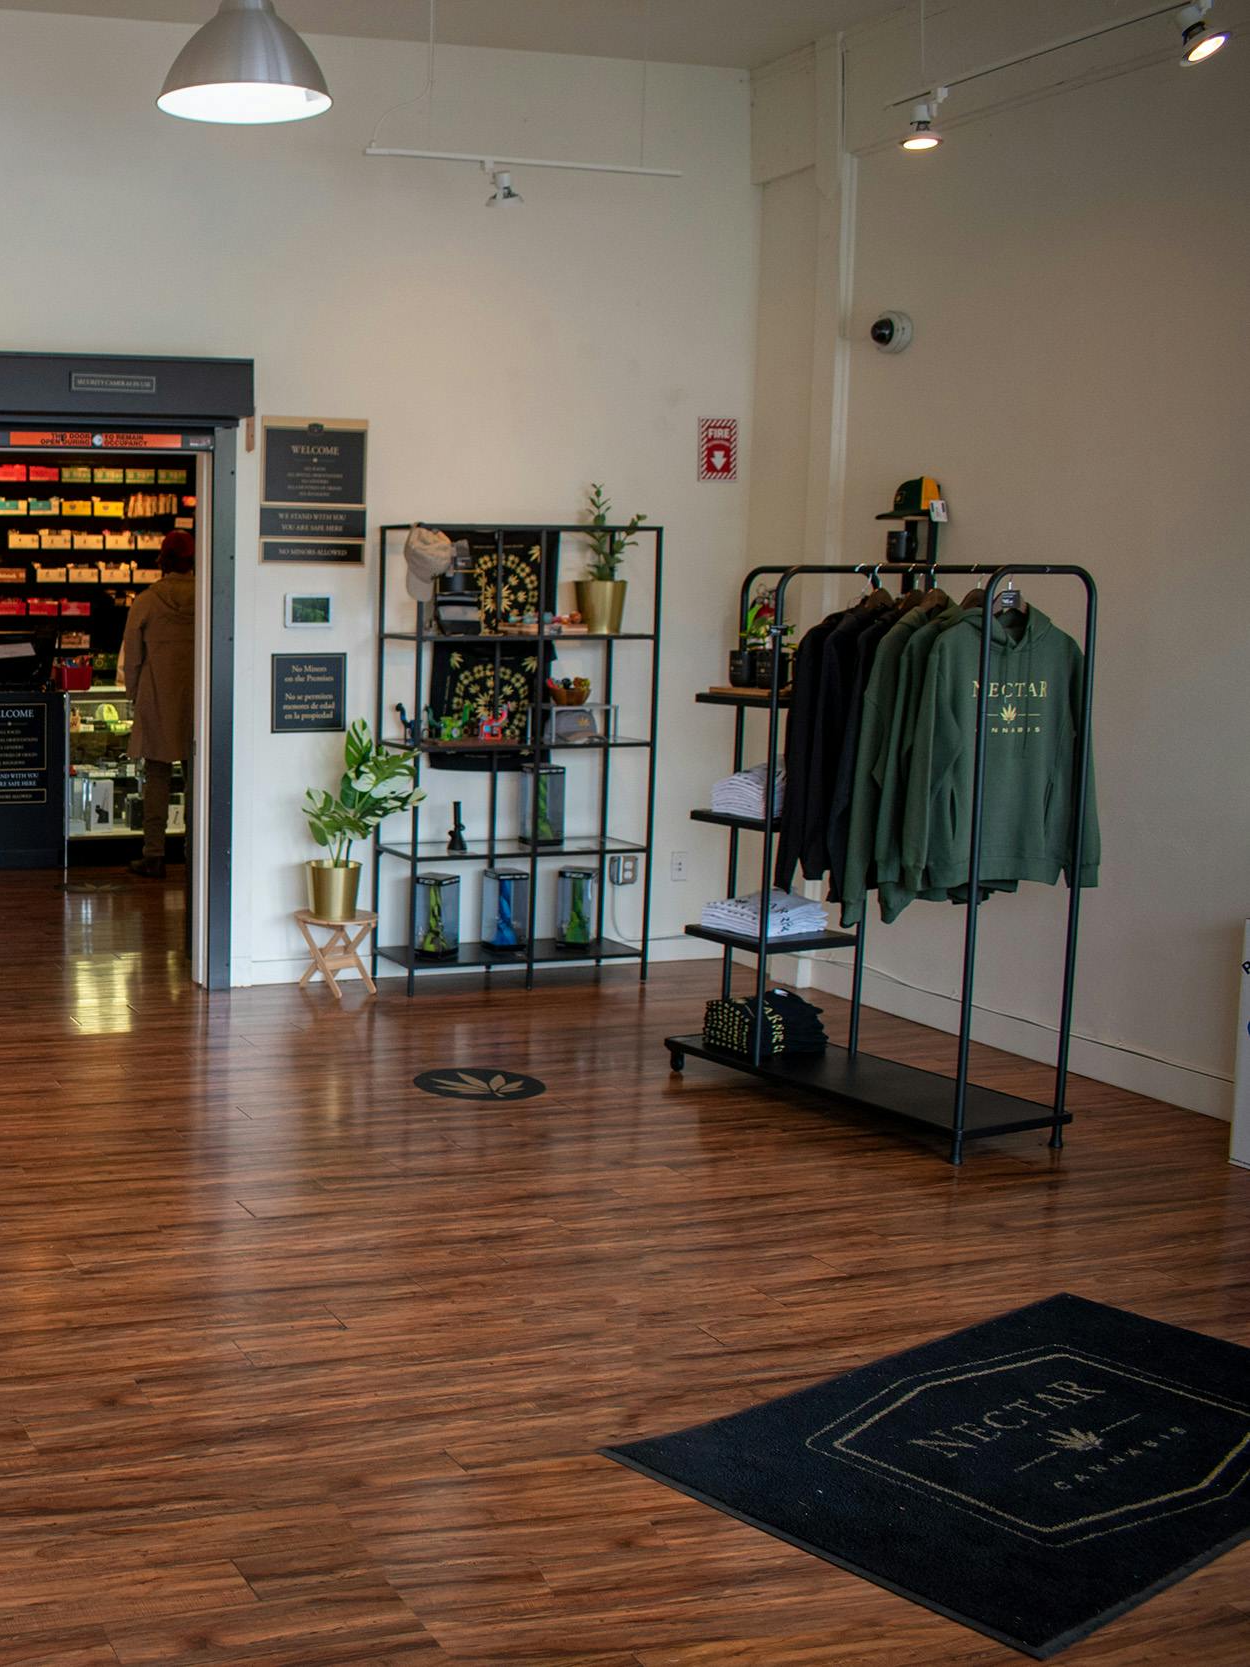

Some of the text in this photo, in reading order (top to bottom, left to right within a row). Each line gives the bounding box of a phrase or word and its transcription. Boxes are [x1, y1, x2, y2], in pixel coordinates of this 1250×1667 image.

[708, 428, 730, 439] FIRE
[291, 445, 340, 456] WELCOME
[278, 512, 289, 520] WE
[314, 513, 332, 521] WITH
[333, 513, 347, 521] YOU
[317, 548, 348, 556] ALLOWED
[306, 674, 334, 682] Premises
[285, 693, 296, 701] No
[304, 692, 334, 702] permiten
[319, 701, 335, 709] edad
[293, 711, 300, 719] la
[301, 711, 334, 720] propiedad
[907, 1381, 1106, 1458] NECTAR
[1054, 1426, 1187, 1490] CANNABIS
